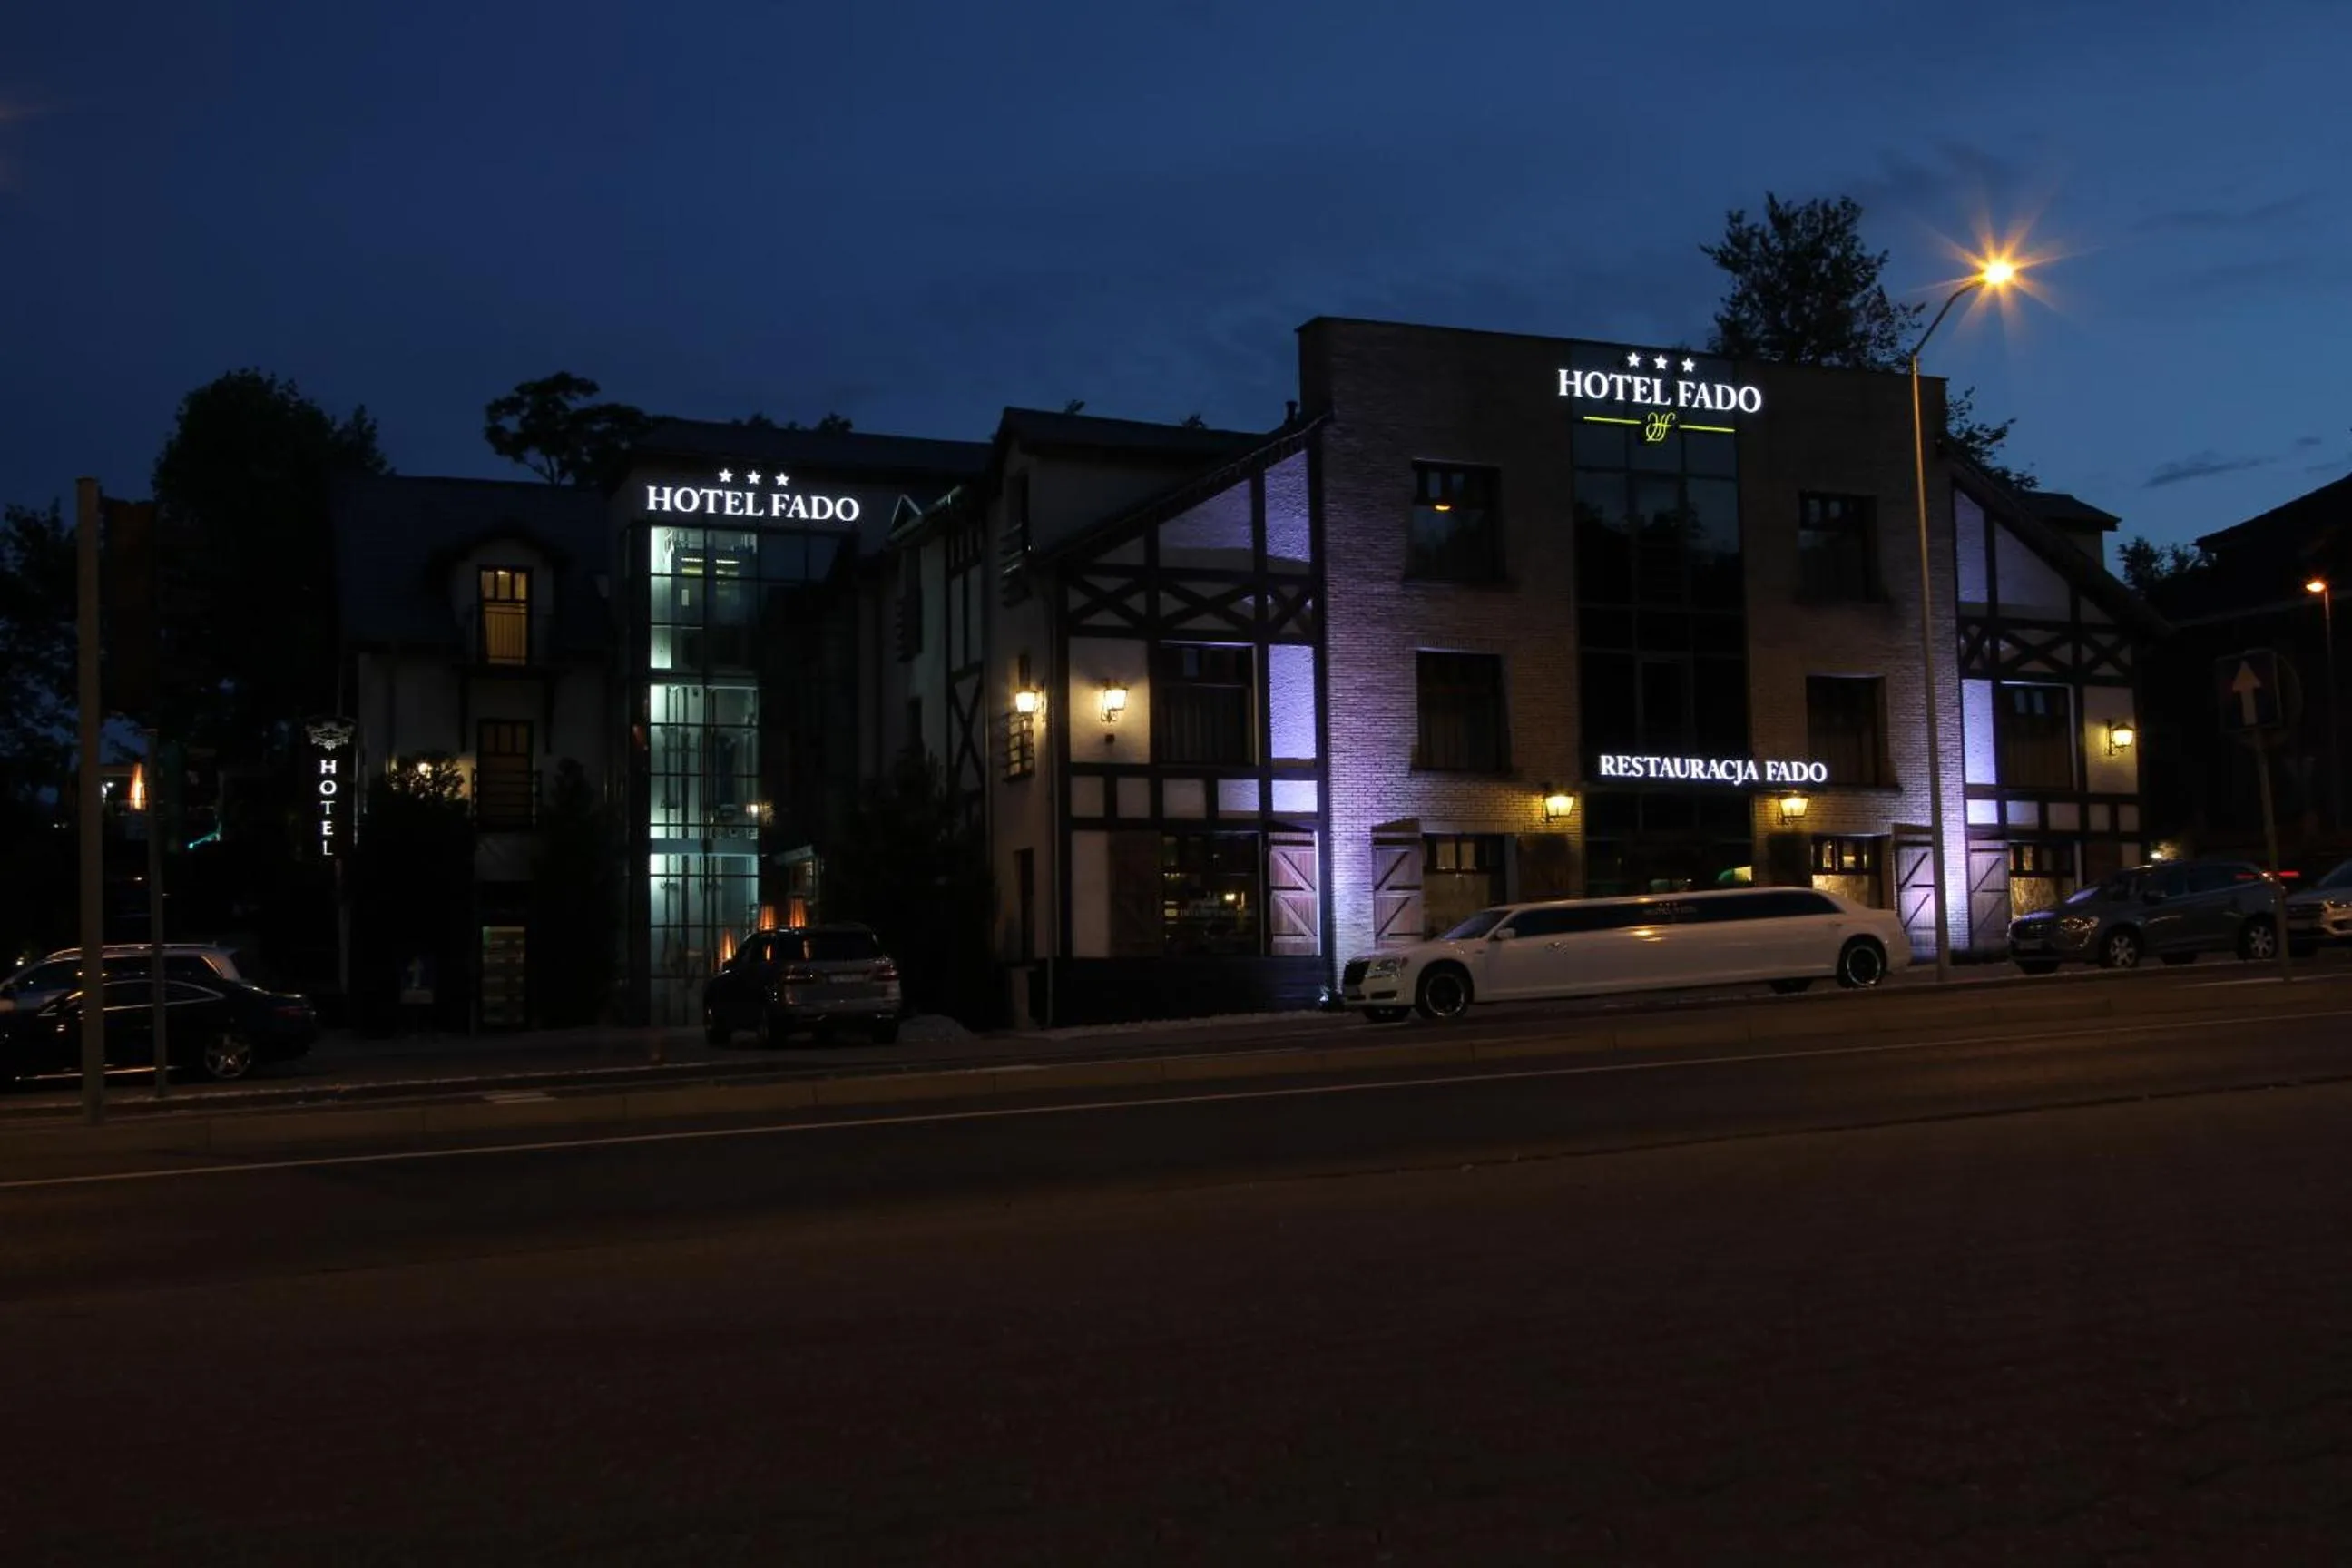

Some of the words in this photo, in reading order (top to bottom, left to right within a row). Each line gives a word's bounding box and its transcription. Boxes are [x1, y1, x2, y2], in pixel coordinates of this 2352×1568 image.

[1558, 368, 1671, 406] HOTEL
[1677, 379, 1762, 414] FADO
[646, 485, 764, 516] HOTEL
[769, 493, 859, 522] FADO
[1600, 754, 1759, 785] RESTAURACJA
[1765, 760, 1827, 783] FADO
[319, 760, 337, 856] HOTEL
